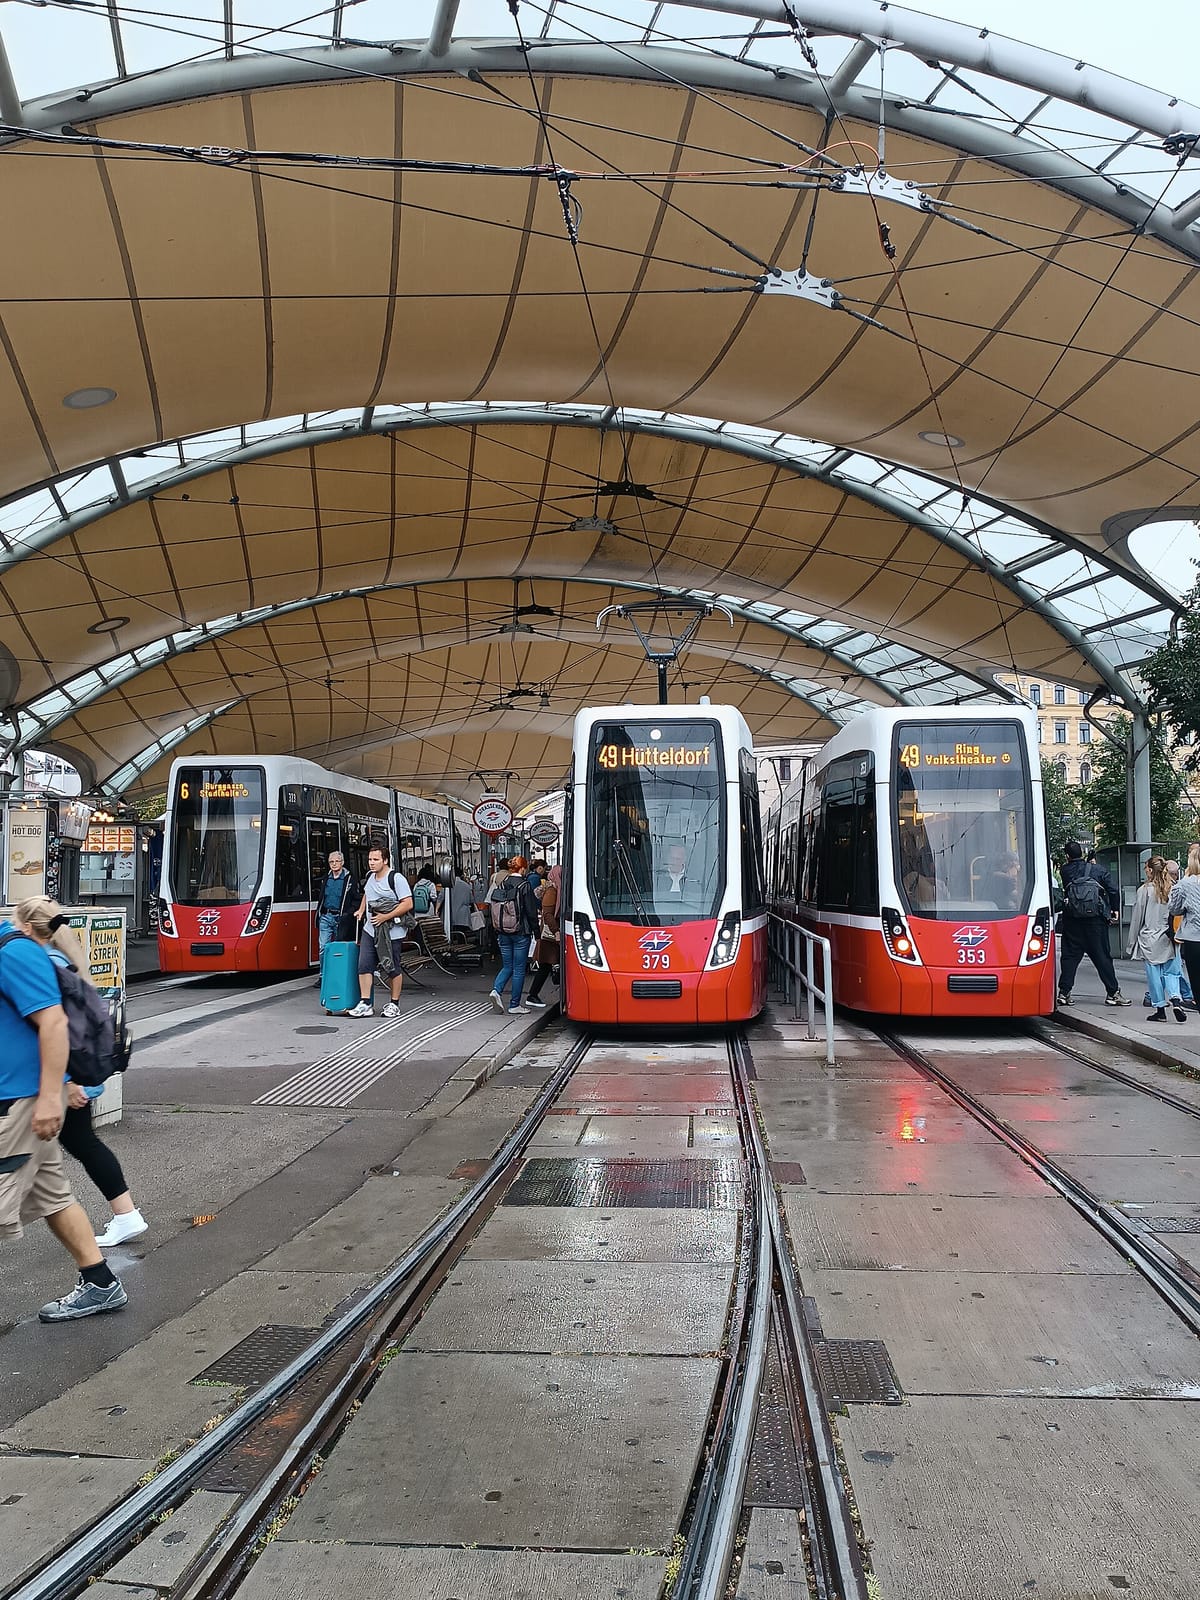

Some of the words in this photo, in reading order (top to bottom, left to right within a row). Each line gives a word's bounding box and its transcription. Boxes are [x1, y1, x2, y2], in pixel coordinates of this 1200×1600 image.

[956, 744, 980, 754] Ring
[599, 745, 618, 768] 49
[622, 747, 710, 765] Hütteldorf
[901, 745, 920, 767] 49
[925, 755, 997, 764] Volkstheater
[181, 783, 189, 799] 6
[199, 789, 240, 798] Stadthalle
[12, 827, 25, 835] HOT
[28, 827, 42, 835] DOG
[199, 925, 218, 935] 323
[94, 932, 118, 945] KLIMA
[93, 946, 119, 960] STREIK
[957, 949, 985, 964] 353
[642, 954, 670, 969] 379
